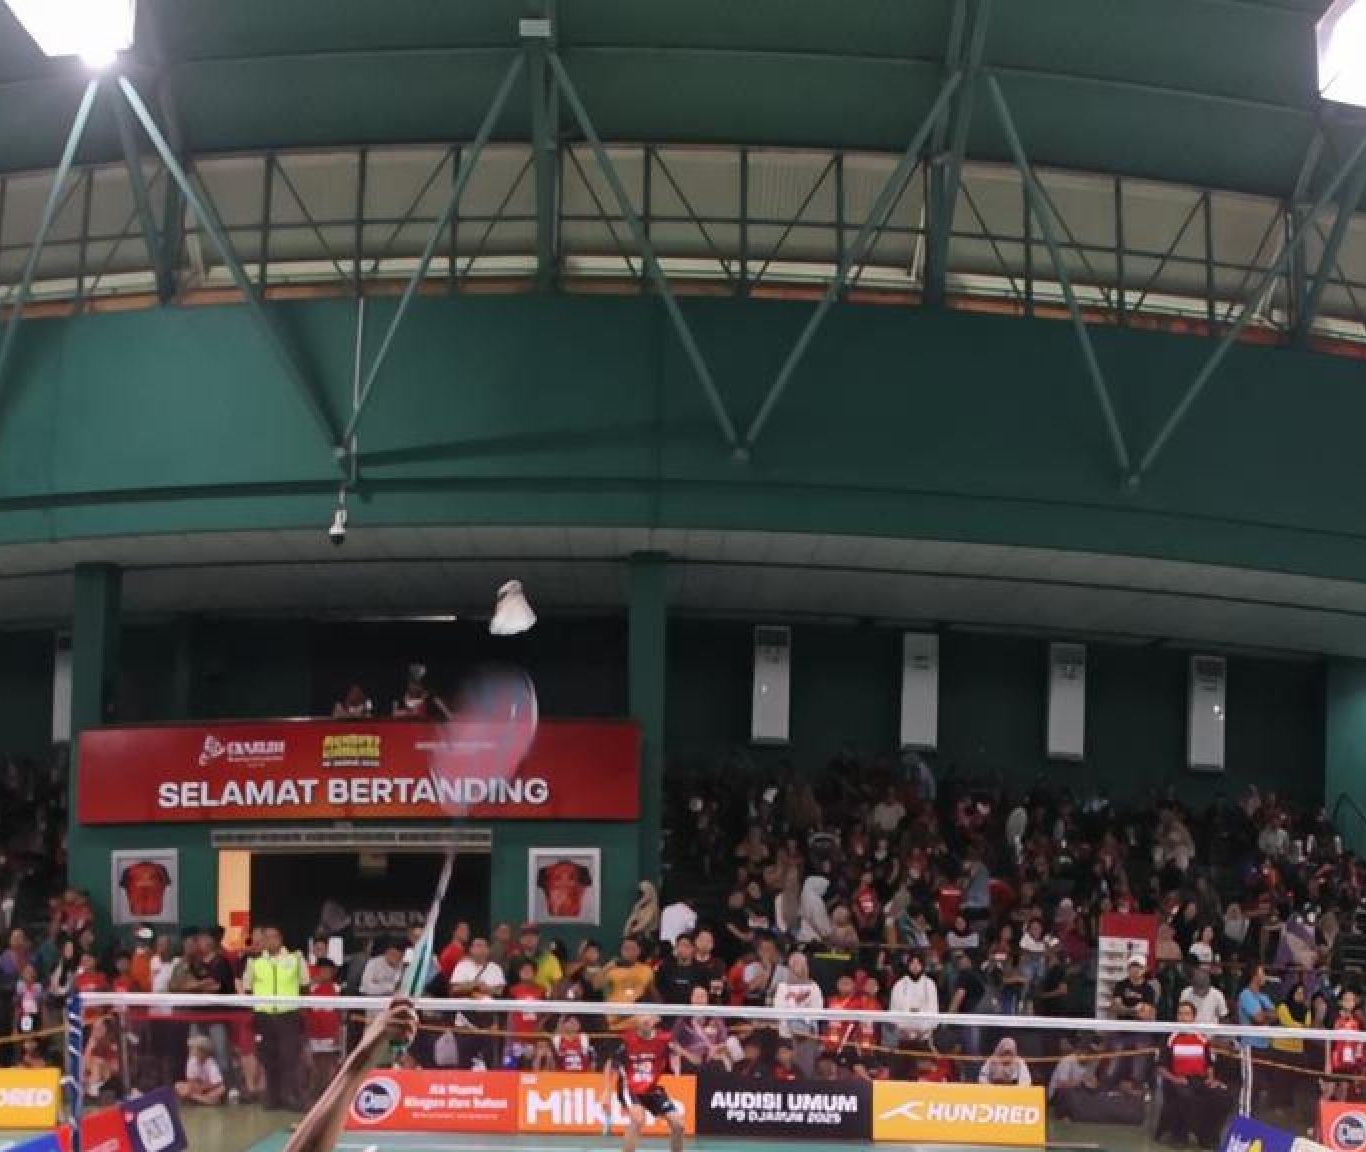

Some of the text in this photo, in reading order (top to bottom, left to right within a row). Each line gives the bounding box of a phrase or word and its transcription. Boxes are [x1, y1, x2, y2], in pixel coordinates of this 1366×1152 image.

[158, 776, 550, 808] SELAMAT BERTANDING
[710, 1091, 858, 1113] AUDISI UMUM
